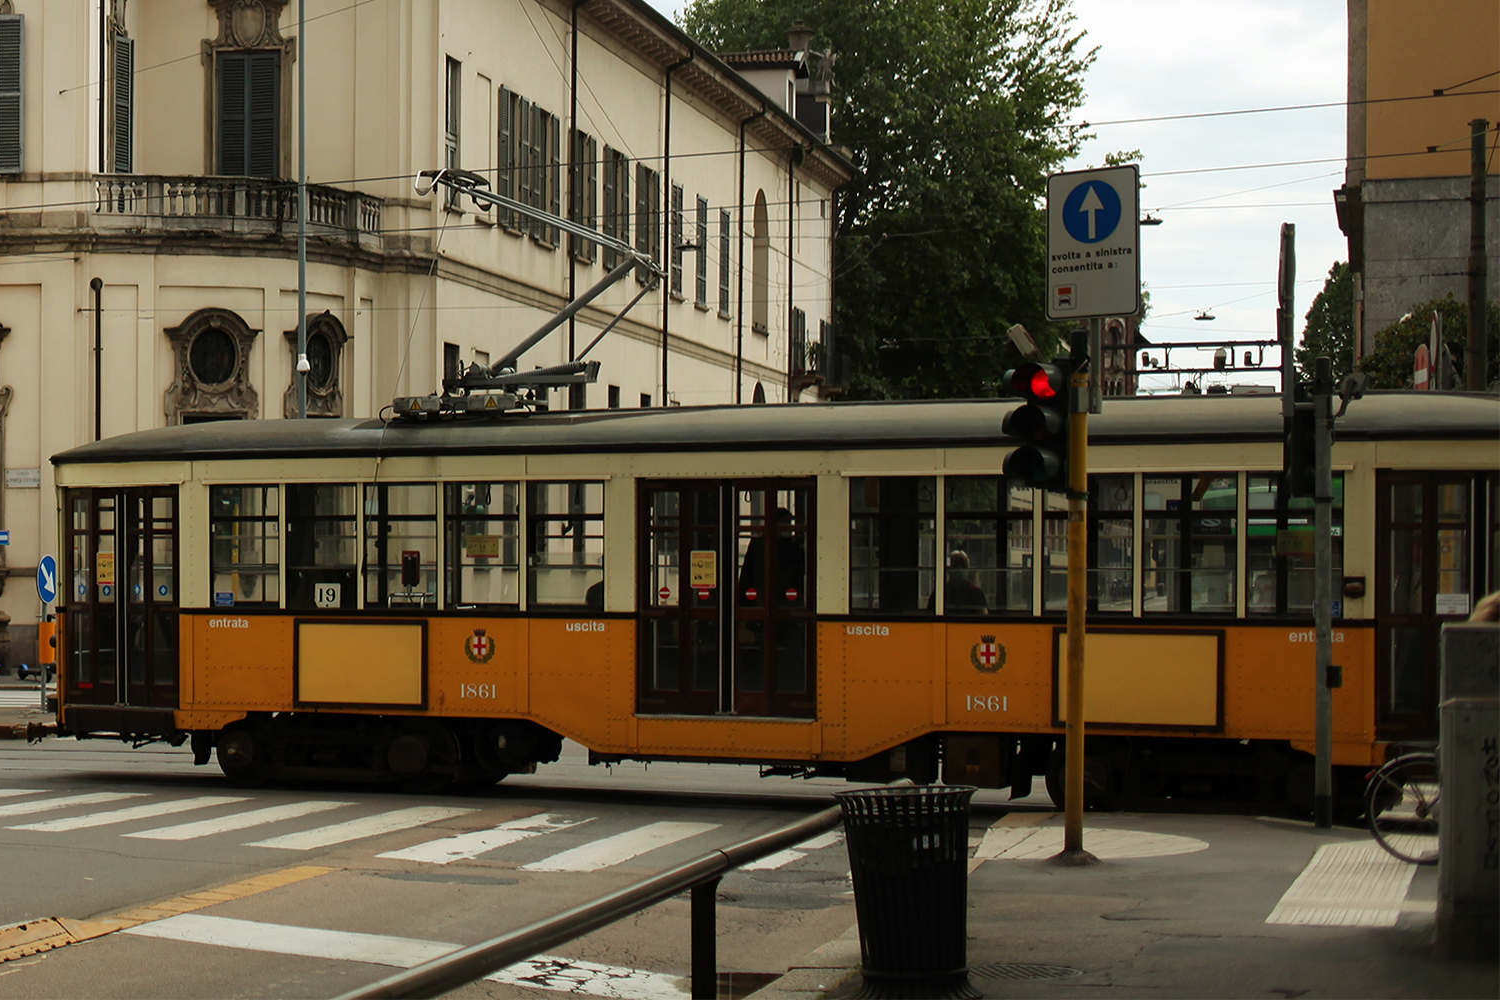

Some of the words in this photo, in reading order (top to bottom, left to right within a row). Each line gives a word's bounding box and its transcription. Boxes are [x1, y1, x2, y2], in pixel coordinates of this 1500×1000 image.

[1051, 251, 1081, 261] svolta
[1095, 247, 1132, 257] sinistra
[1051, 261, 1103, 274] consentita
[318, 587, 336, 602] 19
[209, 618, 249, 628] entrata
[566, 621, 605, 632] uscita
[846, 624, 890, 636] uscita
[1288, 630, 1345, 643] entta
[460, 683, 497, 700] 1861
[966, 694, 1008, 712] 1861
